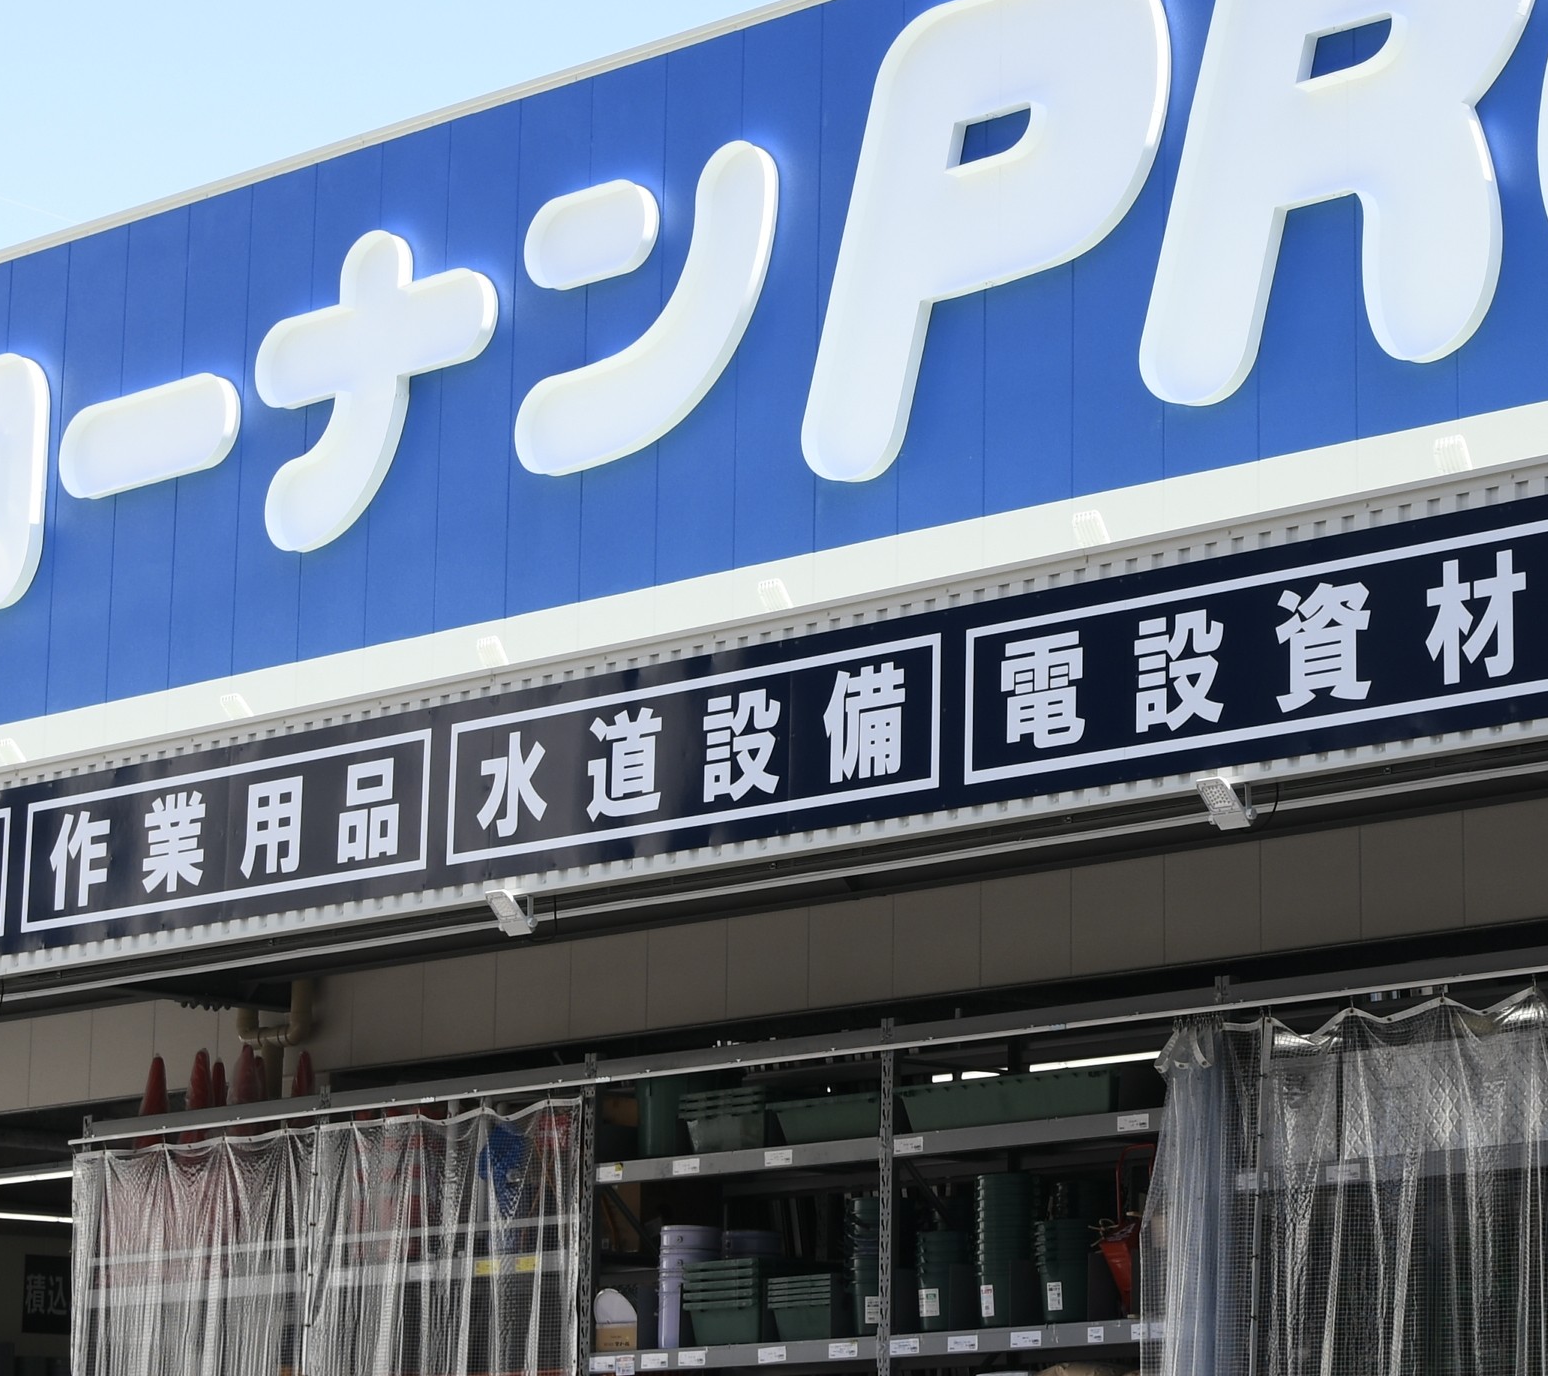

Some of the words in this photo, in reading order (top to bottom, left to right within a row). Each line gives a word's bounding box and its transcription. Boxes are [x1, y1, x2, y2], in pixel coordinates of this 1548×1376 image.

[1001, 550, 1529, 750] 電設資材
[48, 756, 401, 912] 作業用品
[476, 660, 906, 839] 水道設備
